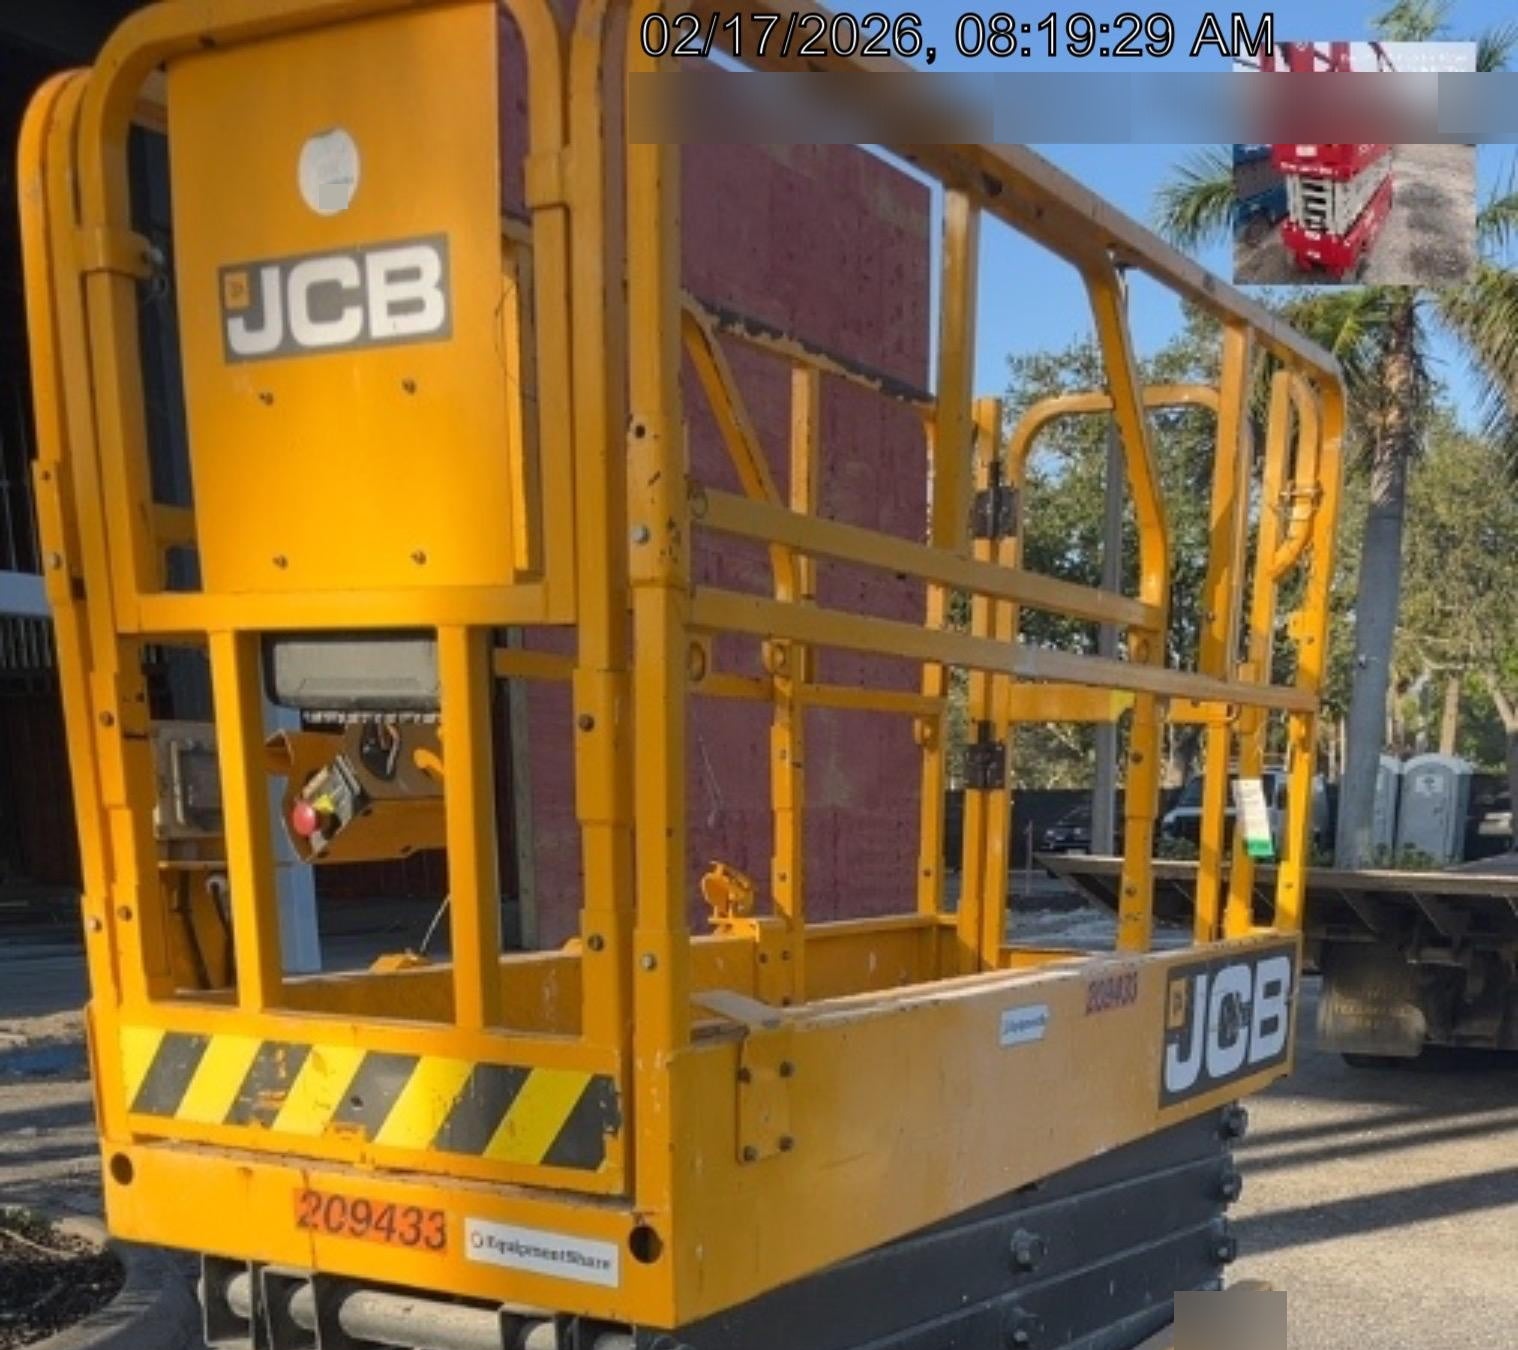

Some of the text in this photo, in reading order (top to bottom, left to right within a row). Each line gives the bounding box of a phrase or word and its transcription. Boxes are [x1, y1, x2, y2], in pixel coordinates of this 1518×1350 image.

[227, 245, 445, 355] JCB
[1165, 956, 1291, 1093] JCB
[297, 1191, 446, 1250] 209433
[487, 1235, 611, 1270] EquipmentShare
